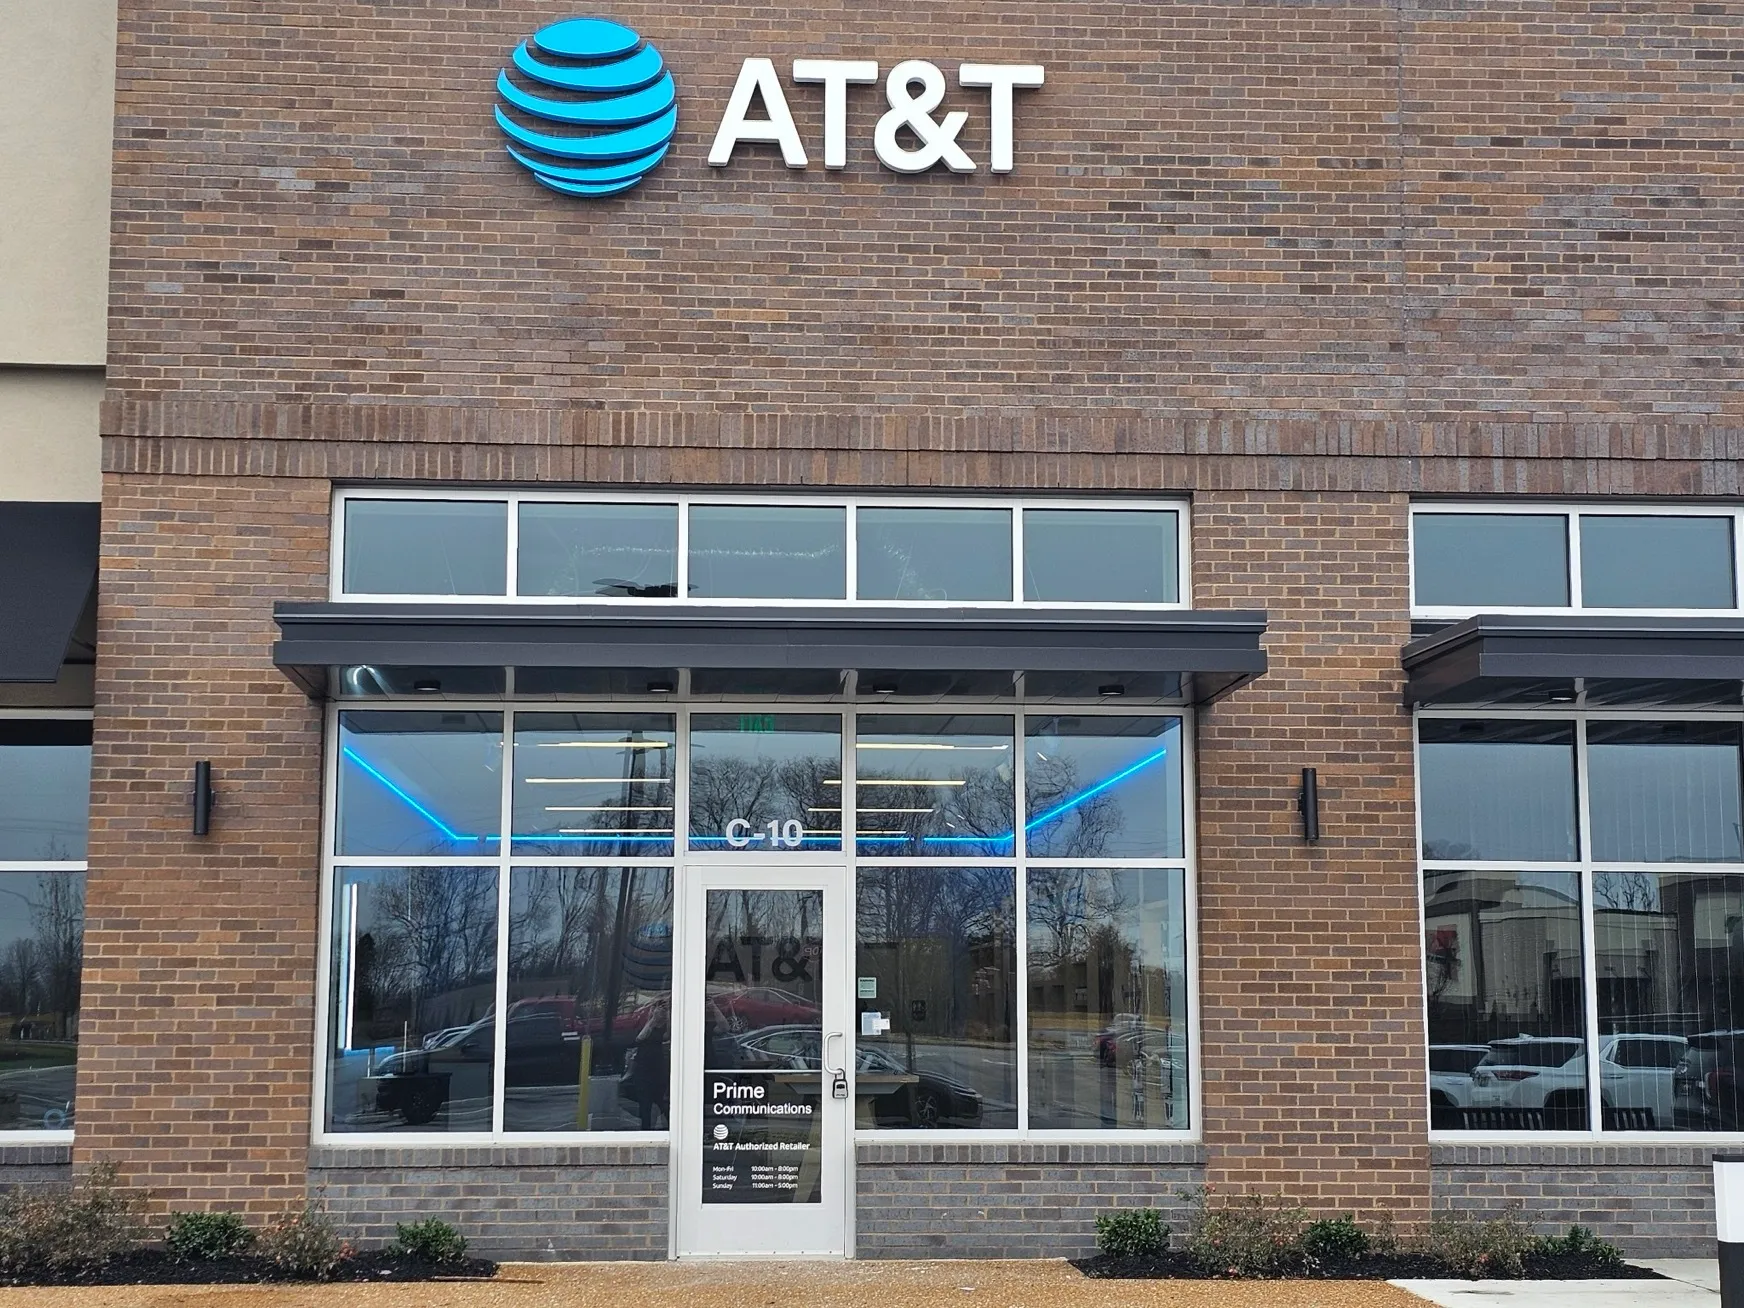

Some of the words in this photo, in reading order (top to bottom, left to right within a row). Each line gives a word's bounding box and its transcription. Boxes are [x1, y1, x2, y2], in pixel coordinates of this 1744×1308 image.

[708, 57, 1045, 174] AT&T
[725, 818, 803, 847] C-10
[713, 1082, 765, 1099] Prime
[713, 1102, 813, 1115] Communications
[713, 1142, 734, 1151] AT&T
[735, 1142, 779, 1151] Authorized
[779, 1142, 811, 1151] Retailer
[712, 1174, 738, 1182] Saturday
